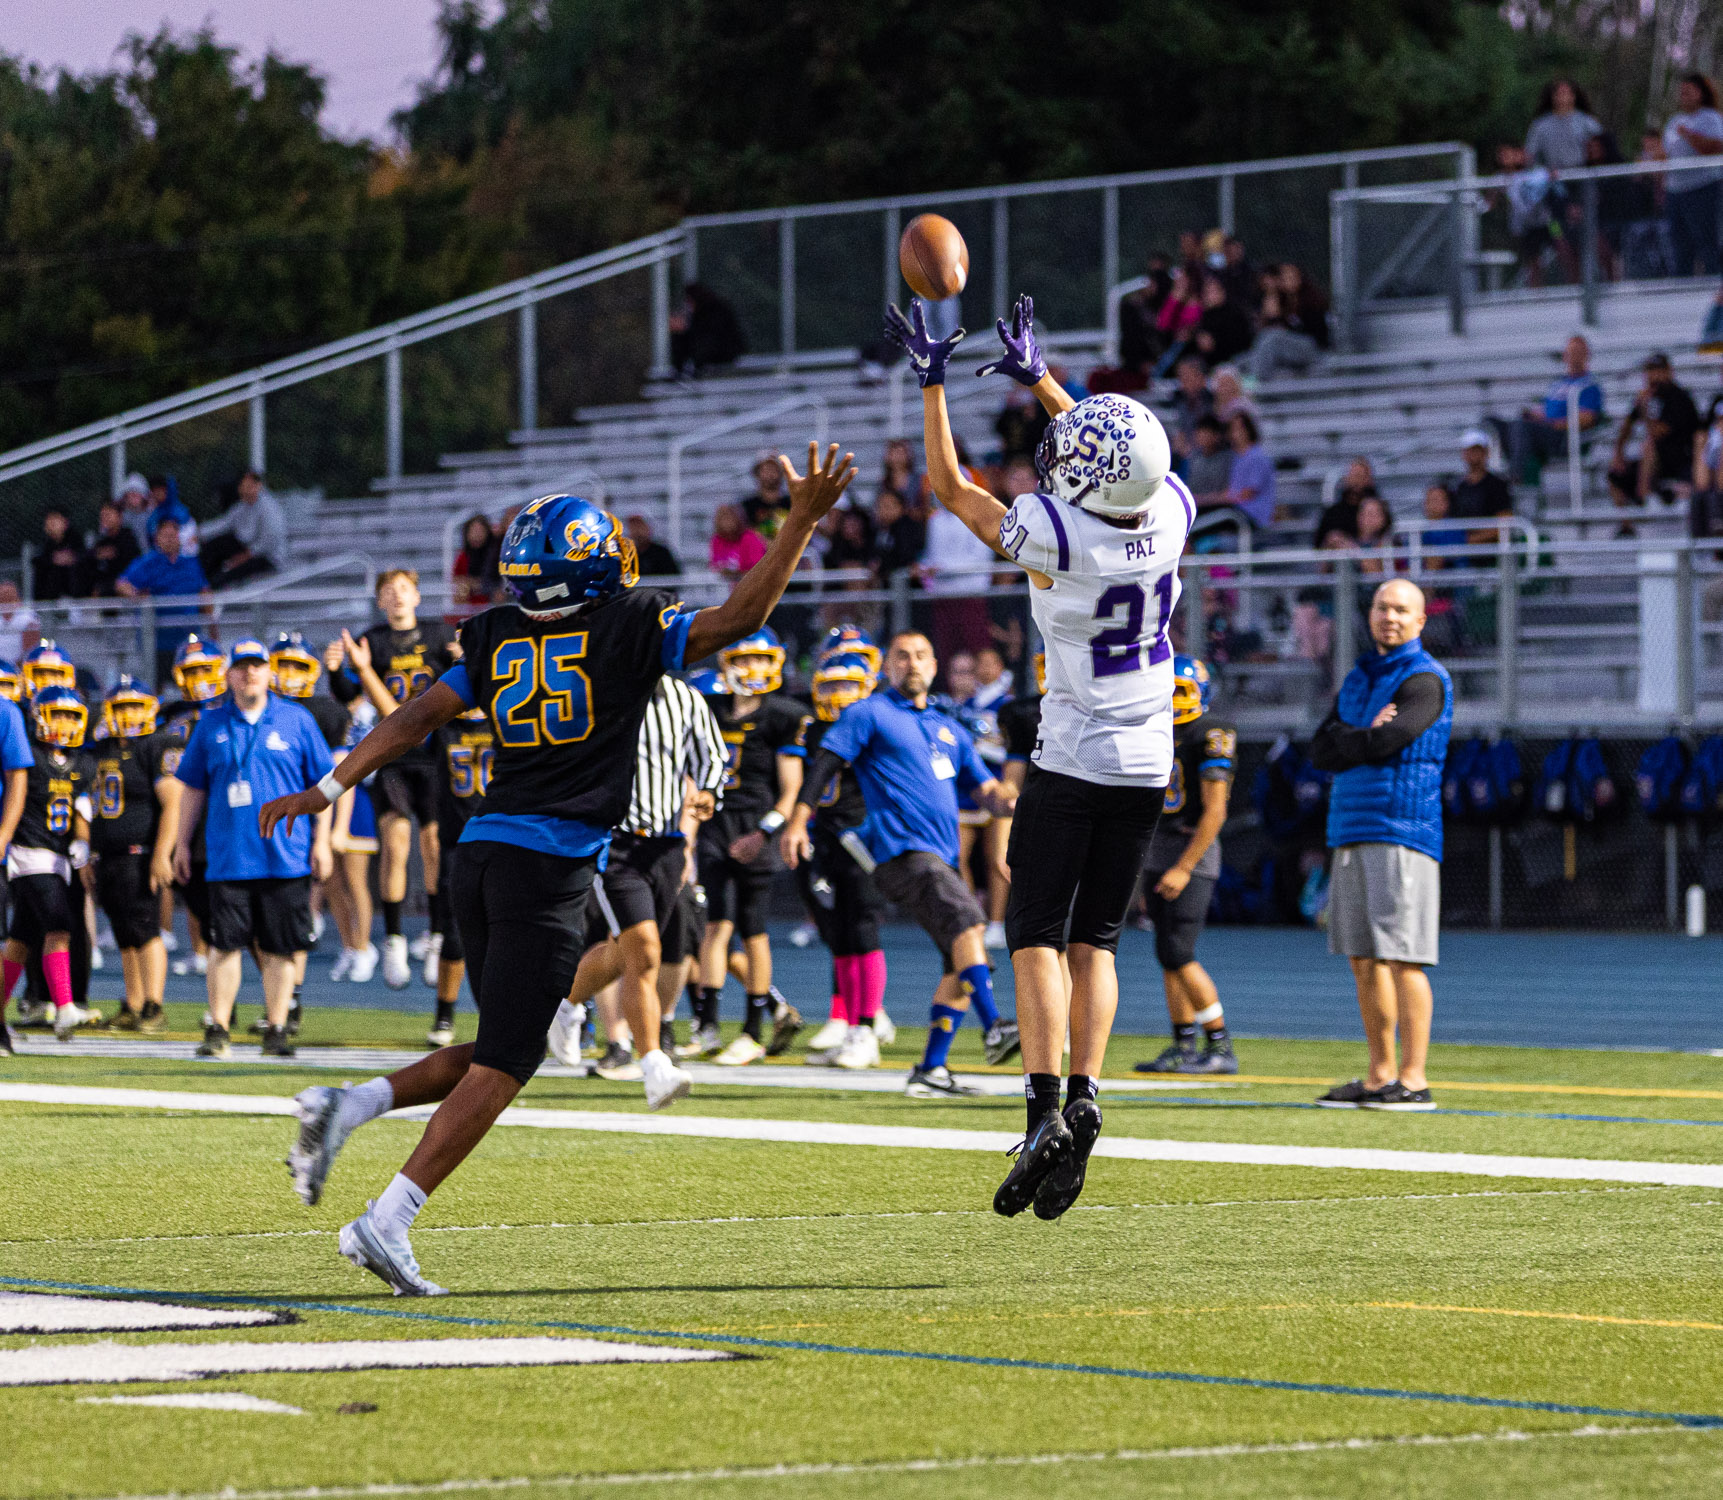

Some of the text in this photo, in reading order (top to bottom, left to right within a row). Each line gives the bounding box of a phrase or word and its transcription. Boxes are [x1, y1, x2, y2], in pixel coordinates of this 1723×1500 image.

[1073, 425, 1107, 463] S
[1125, 537, 1156, 561] PAZ
[1088, 569, 1174, 680] 21
[491, 630, 595, 747] 25
